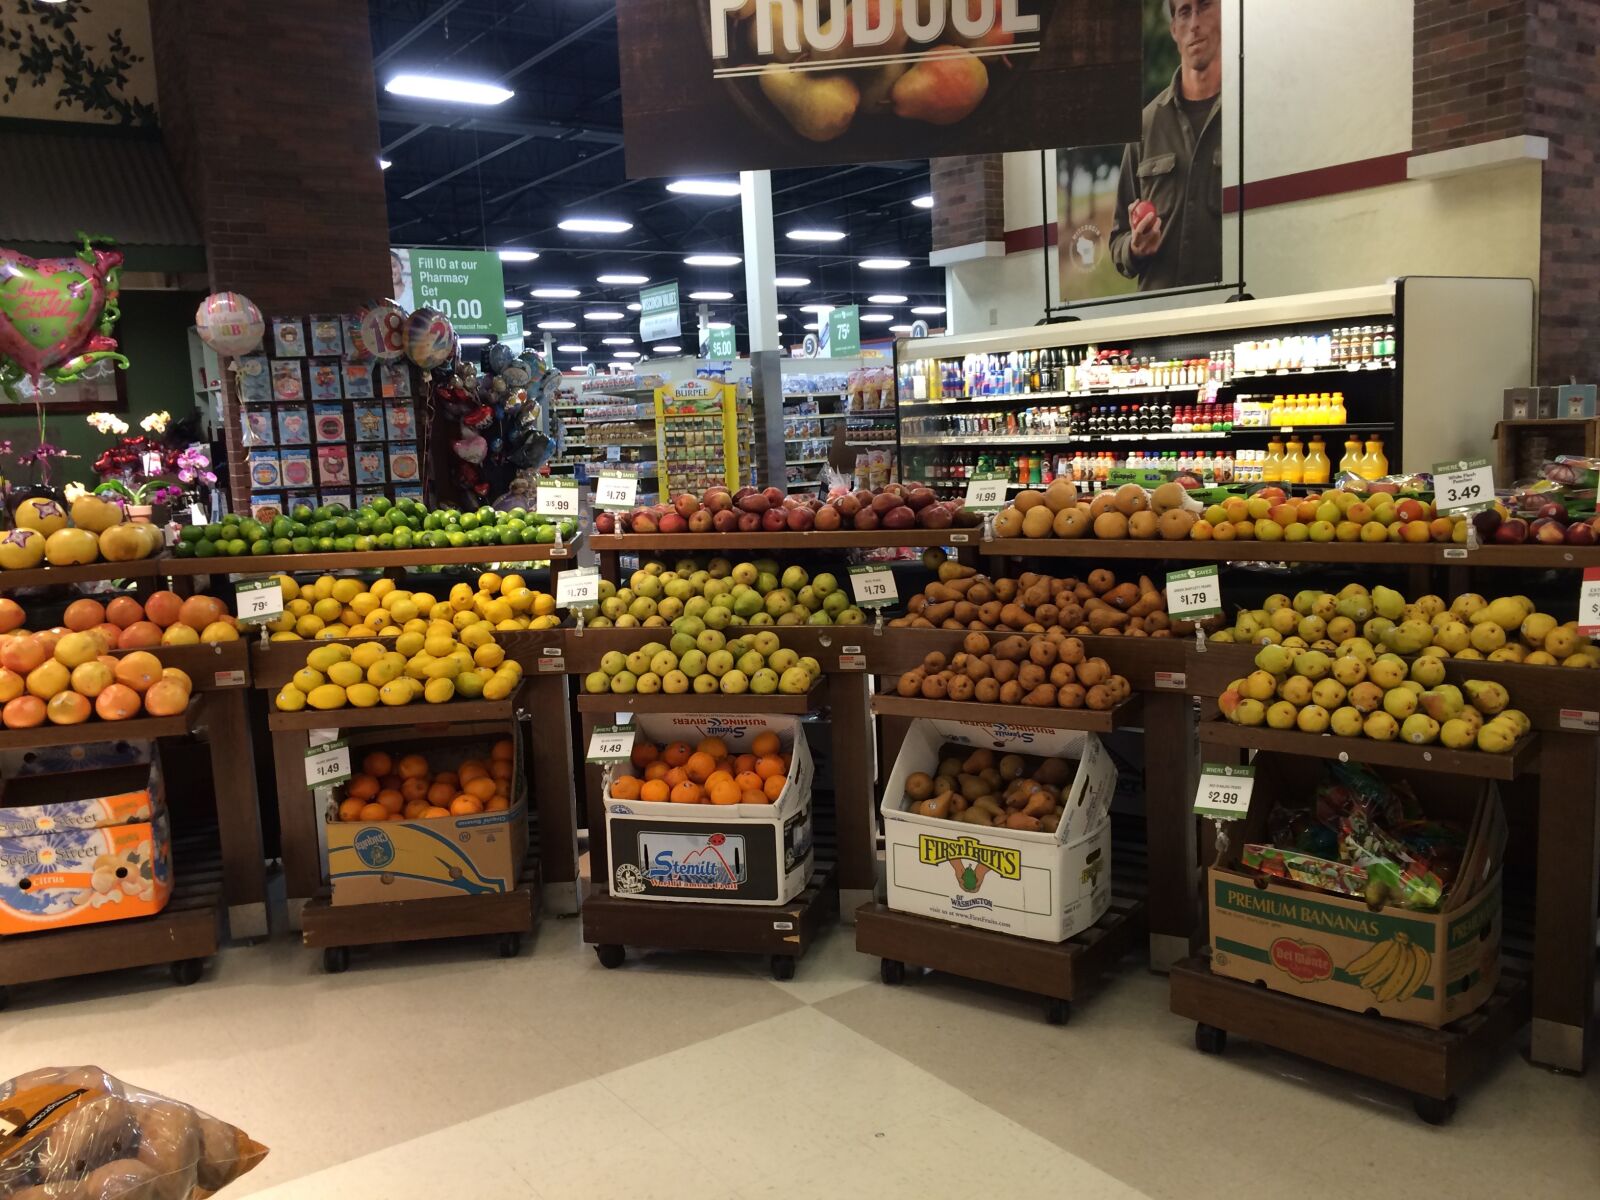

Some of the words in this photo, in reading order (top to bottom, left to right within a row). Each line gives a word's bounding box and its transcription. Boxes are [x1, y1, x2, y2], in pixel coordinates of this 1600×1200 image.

[418, 257, 433, 268] Fill
[436, 258, 446, 268] 10
[449, 259, 459, 269] at
[461, 261, 477, 270] our
[420, 272, 469, 286] Pharmacy
[421, 285, 438, 296] Get
[369, 312, 404, 353] 18
[836, 323, 850, 340] 75¢
[713, 341, 732, 357] $5.00
[806, 340, 812, 352] 5
[675, 388, 708, 398] BURPEE
[606, 491, 626, 500] $1.79
[976, 492, 996, 502] $1.99
[1448, 485, 1481, 501] 3.49
[567, 587, 588, 597] $1.79
[864, 584, 886, 595] $1.79
[1180, 592, 1207, 605] $1.79
[252, 601, 268, 612] 79¢
[707, 726, 747, 738] Stemilt
[994, 730, 1034, 743] Stemilt
[600, 744, 622, 753] $1.49
[317, 762, 340, 776] $1.49
[1208, 791, 1238, 805] $2.99
[355, 833, 389, 850] Chiquita
[55, 846, 98, 862] Sweet
[649, 850, 718, 876] Stemilt
[33, 876, 65, 887] citrus
[951, 897, 993, 908] WASHINGTON
[1228, 890, 1296, 919] PREMIUM
[1301, 907, 1379, 937] BANANAS
[1276, 947, 1293, 961] Del
[1294, 953, 1329, 970] Monte
